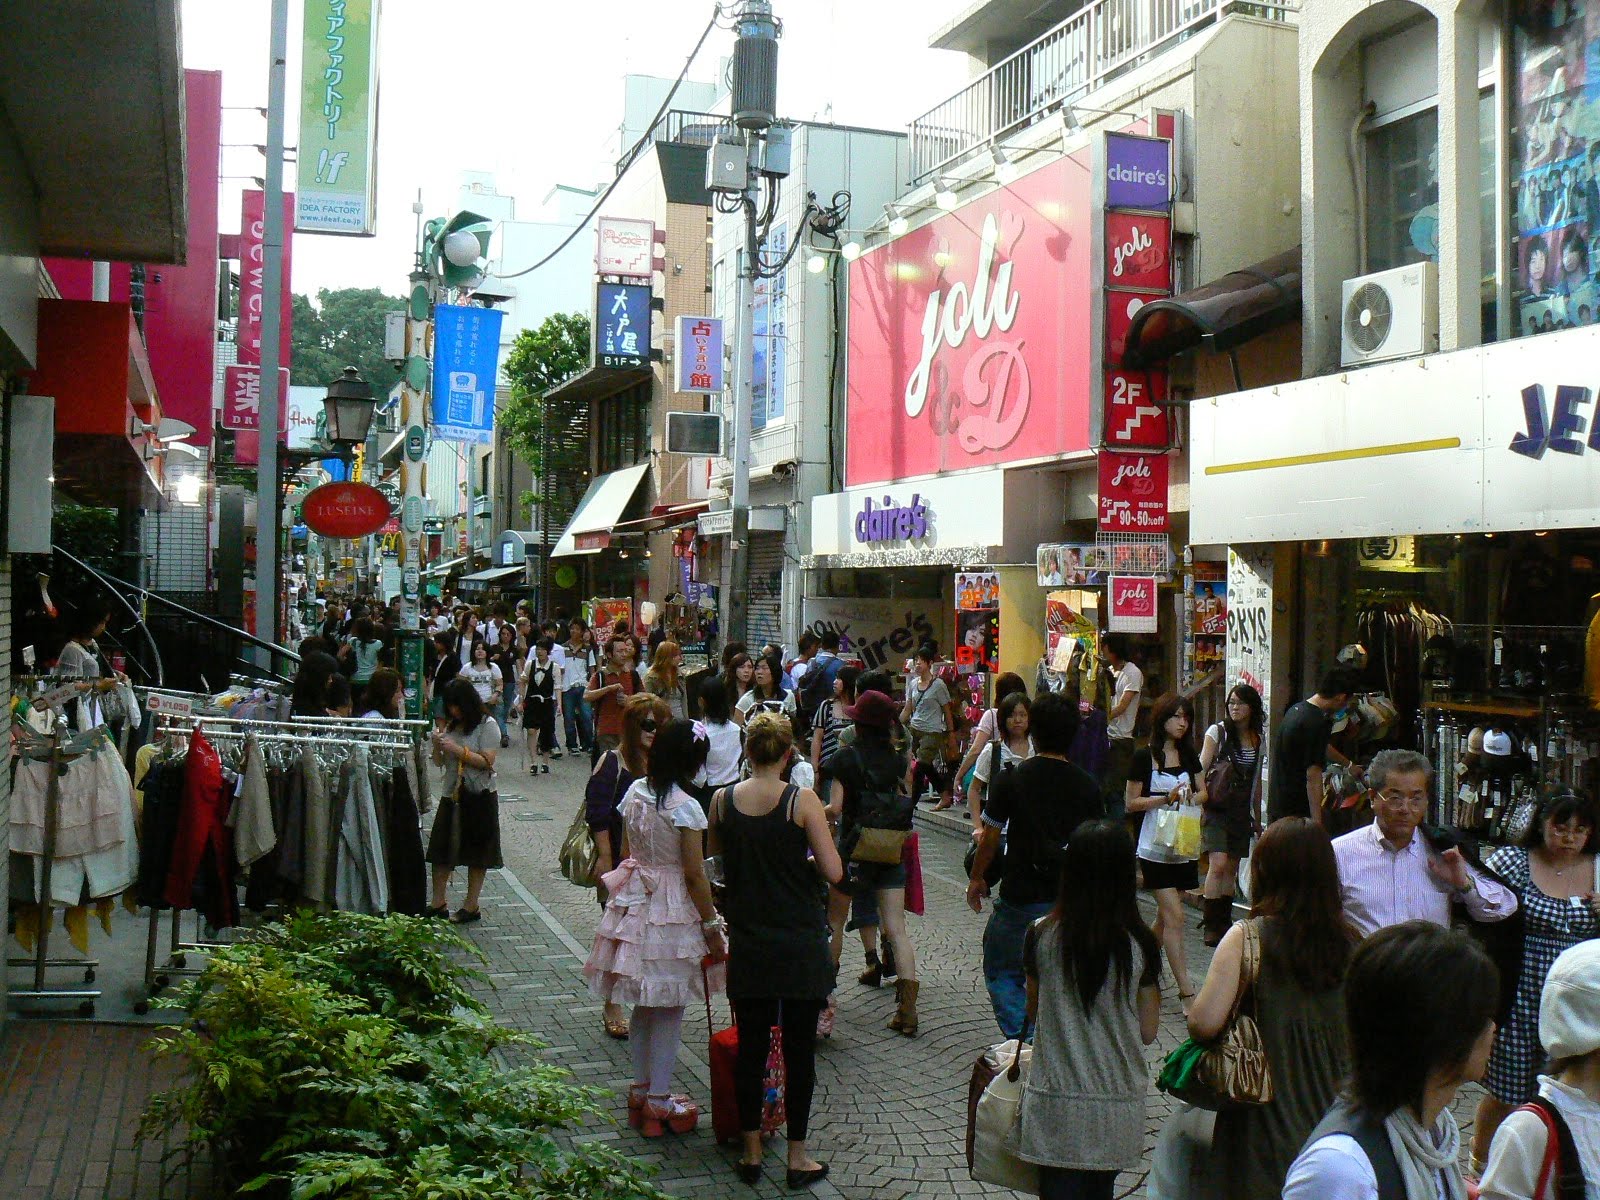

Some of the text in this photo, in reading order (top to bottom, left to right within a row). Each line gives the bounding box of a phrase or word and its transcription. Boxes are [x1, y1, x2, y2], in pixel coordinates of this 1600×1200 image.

[324, 0, 346, 140] ィアファクトリー
[1107, 163, 1167, 187] claire's
[300, 203, 362, 215] IDEA FACTORY
[300, 215, 362, 226] www.ideaf.co.jp
[602, 257, 615, 265] 3F
[1112, 226, 1153, 277] joli
[611, 288, 640, 356] 大戸屋
[904, 212, 1019, 418] joli
[604, 356, 628, 366] B1F
[690, 320, 712, 389] 占い予言の館
[1112, 376, 1143, 405] 2F
[1507, 382, 1600, 461] JE
[1111, 456, 1152, 487] joli
[318, 505, 376, 517] LUSEINE
[1101, 496, 1113, 508] 2F
[855, 493, 927, 544] claire's
[1116, 582, 1148, 607] joli
[1256, 587, 1268, 599] BNE
[1196, 598, 1216, 613] 2F
[957, 645, 986, 665] B1
